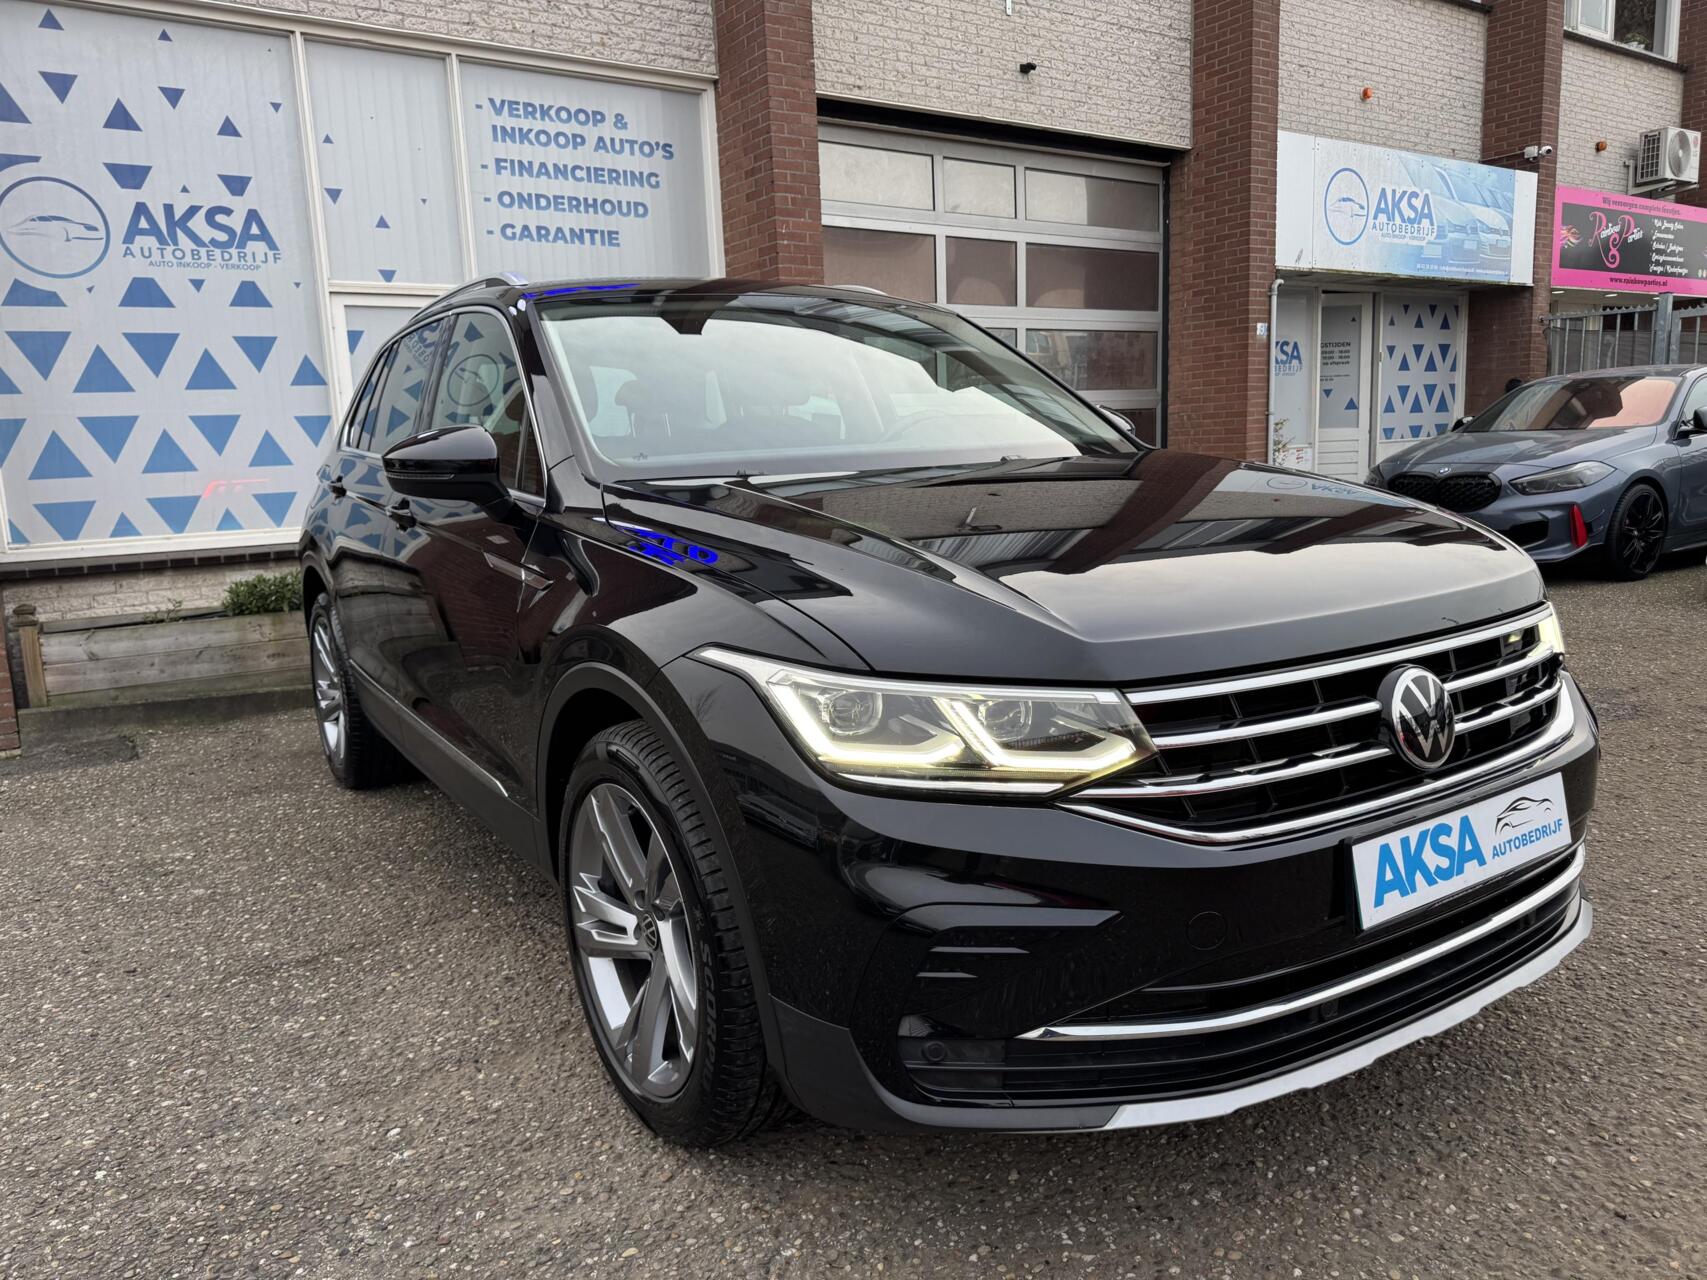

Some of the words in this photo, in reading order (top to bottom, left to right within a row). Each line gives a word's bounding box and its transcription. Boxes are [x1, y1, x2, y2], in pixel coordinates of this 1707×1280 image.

[487, 98, 606, 127] VERKOOP
[613, 113, 628, 130] &
[491, 124, 586, 150] INKOOP
[593, 136, 674, 160] AUTO'S
[494, 157, 660, 189] FINANCIERING
[497, 190, 649, 218] ONDERHOUD
[1372, 187, 1435, 226] AKSA
[121, 202, 281, 251] AKSA
[500, 223, 621, 248] GARANTIE
[1371, 221, 1435, 237] AUTOBEDRIJF
[122, 246, 283, 264] AUTOBEDRIJF
[148, 260, 174, 268] AUTO
[176, 261, 213, 270] INKOOP
[218, 263, 262, 272] VERKOOP
[1491, 818, 1563, 860] AUTOBEDRIJF
[1373, 814, 1487, 909] AKSA
